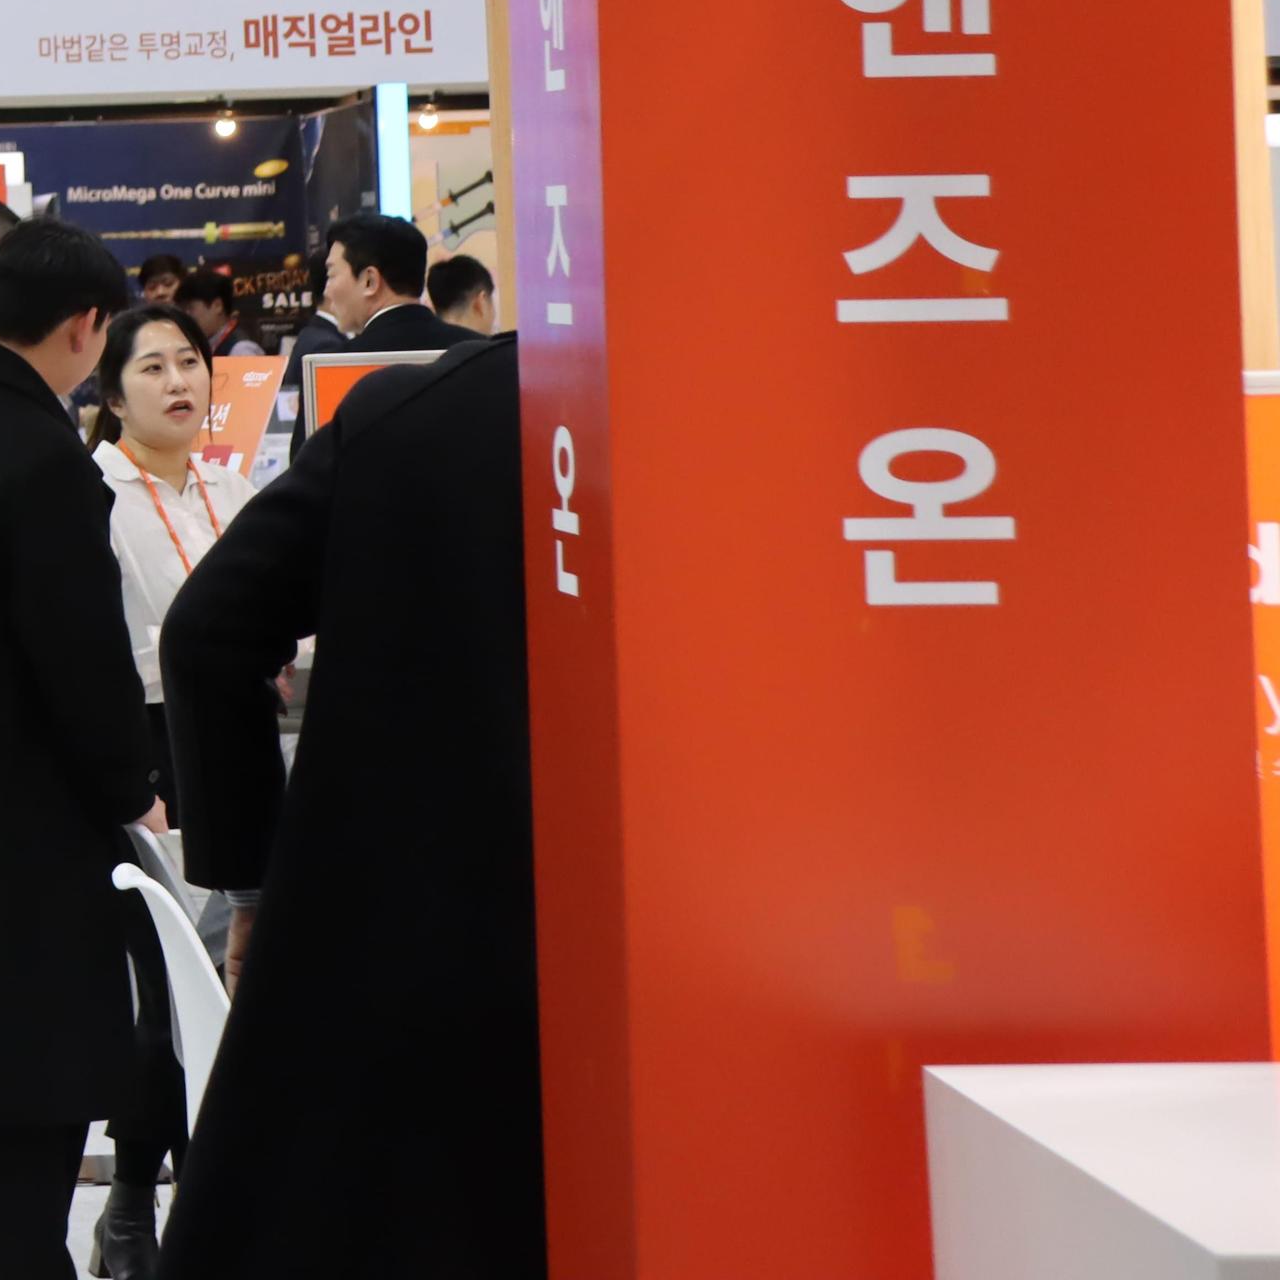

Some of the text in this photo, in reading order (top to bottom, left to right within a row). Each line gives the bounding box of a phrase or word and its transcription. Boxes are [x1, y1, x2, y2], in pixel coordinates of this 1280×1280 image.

[38, 33, 129, 64] 마법같은
[243, 10, 434, 59] 매직얼라인
[67, 180, 276, 206] MicroMega One Curve mini
[262, 291, 312, 309] SALE
